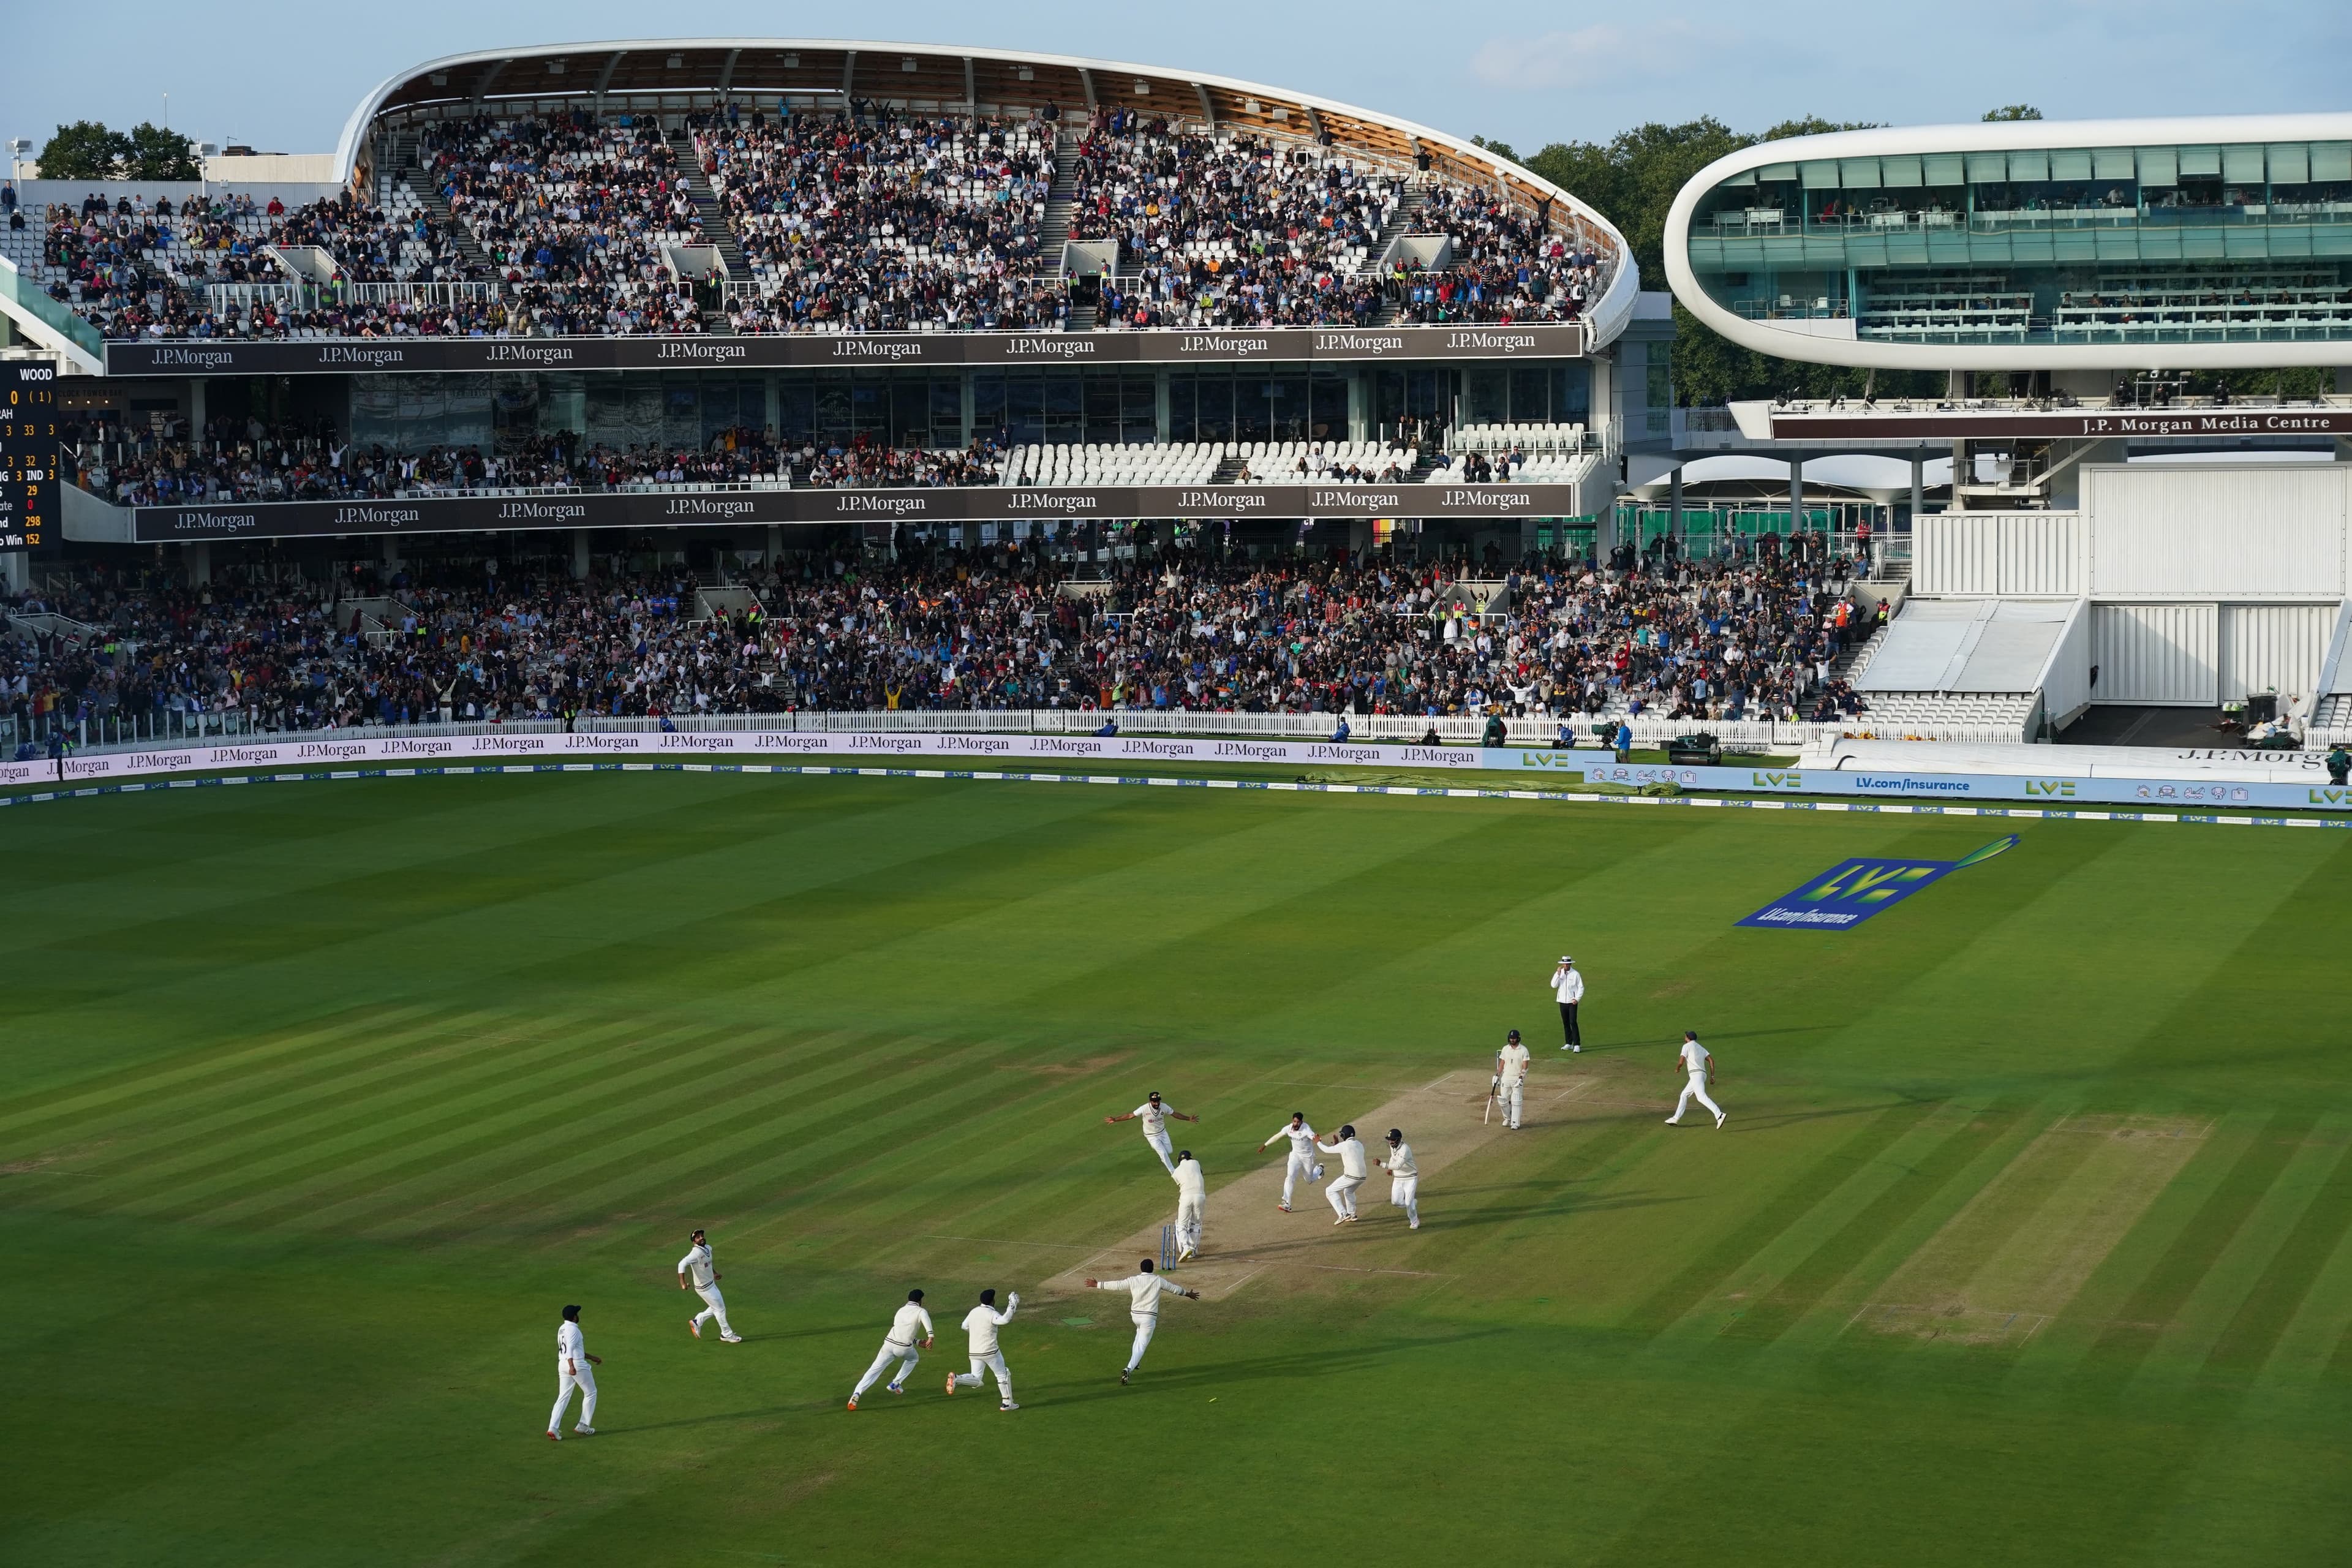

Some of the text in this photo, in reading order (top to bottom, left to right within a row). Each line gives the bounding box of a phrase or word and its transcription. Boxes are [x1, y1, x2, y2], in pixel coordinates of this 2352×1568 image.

[833, 341, 921, 360] J.P.Morgan
[1007, 339, 1095, 357] J.P.Morgan
[1181, 337, 1268, 355] J.P.Morgan
[1316, 335, 1403, 353] J.P.Morgan
[1447, 333, 1535, 352] J.P.Morgan
[152, 349, 233, 369] J.P.Morgan
[319, 348, 403, 366] J.P.Morgan
[487, 345, 573, 364] J.P.Morgan
[658, 344, 745, 361] J.P.Morgan
[20, 369, 53, 380] WOOD
[6, 424, 54, 436] 3 33 3
[2121, 418, 2192, 434] Morgan
[2201, 417, 2259, 430] Media
[2267, 416, 2330, 429] Centre
[7, 455, 56, 467] 3 32 3
[0, 469, 54, 481] G 3 IND 3
[27, 485, 37, 496] 29
[28, 500, 33, 510] 0
[666, 499, 755, 518] J.P.Morgan
[837, 496, 925, 514] J.P.Morgan
[1008, 494, 1096, 512] J.P.Morgan
[1178, 492, 1265, 511] J.P.Morgan
[1312, 492, 1398, 511] J.P.Morgan
[1442, 491, 1530, 510] J.P.Morgan
[335, 508, 419, 526] J.P.Morgan
[499, 503, 585, 521] J.P.Morgan
[25, 516, 40, 526] 298
[175, 513, 255, 532] J.P.Morgan
[6, 535, 23, 545] Win
[26, 534, 40, 544] 152
[382, 741, 451, 756] J.P.Morgan
[472, 738, 544, 753] J.P.Morgan
[566, 736, 638, 751] J.P.Morgan
[661, 736, 733, 751] J.P.Morgan
[755, 736, 827, 751] J.P.Morgan
[850, 736, 921, 752] J.P.Morgan
[938, 737, 1009, 753] J.P.Morgan
[1030, 739, 1101, 755] J.P.Morgan
[1122, 741, 1193, 758] J.P.Morgan
[209, 748, 277, 764] J.P.Morgan
[298, 745, 366, 759] J.P.Morgan
[1215, 744, 1286, 760] J.P.Morgan
[1308, 746, 1379, 763] J.P.Morgan
[1401, 748, 1474, 766] J.P.Morgan
[47, 761, 109, 776] J.Morgan
[127, 753, 191, 769] J.P.Morgan
[1856, 777, 1970, 791] LV.com/insurance
